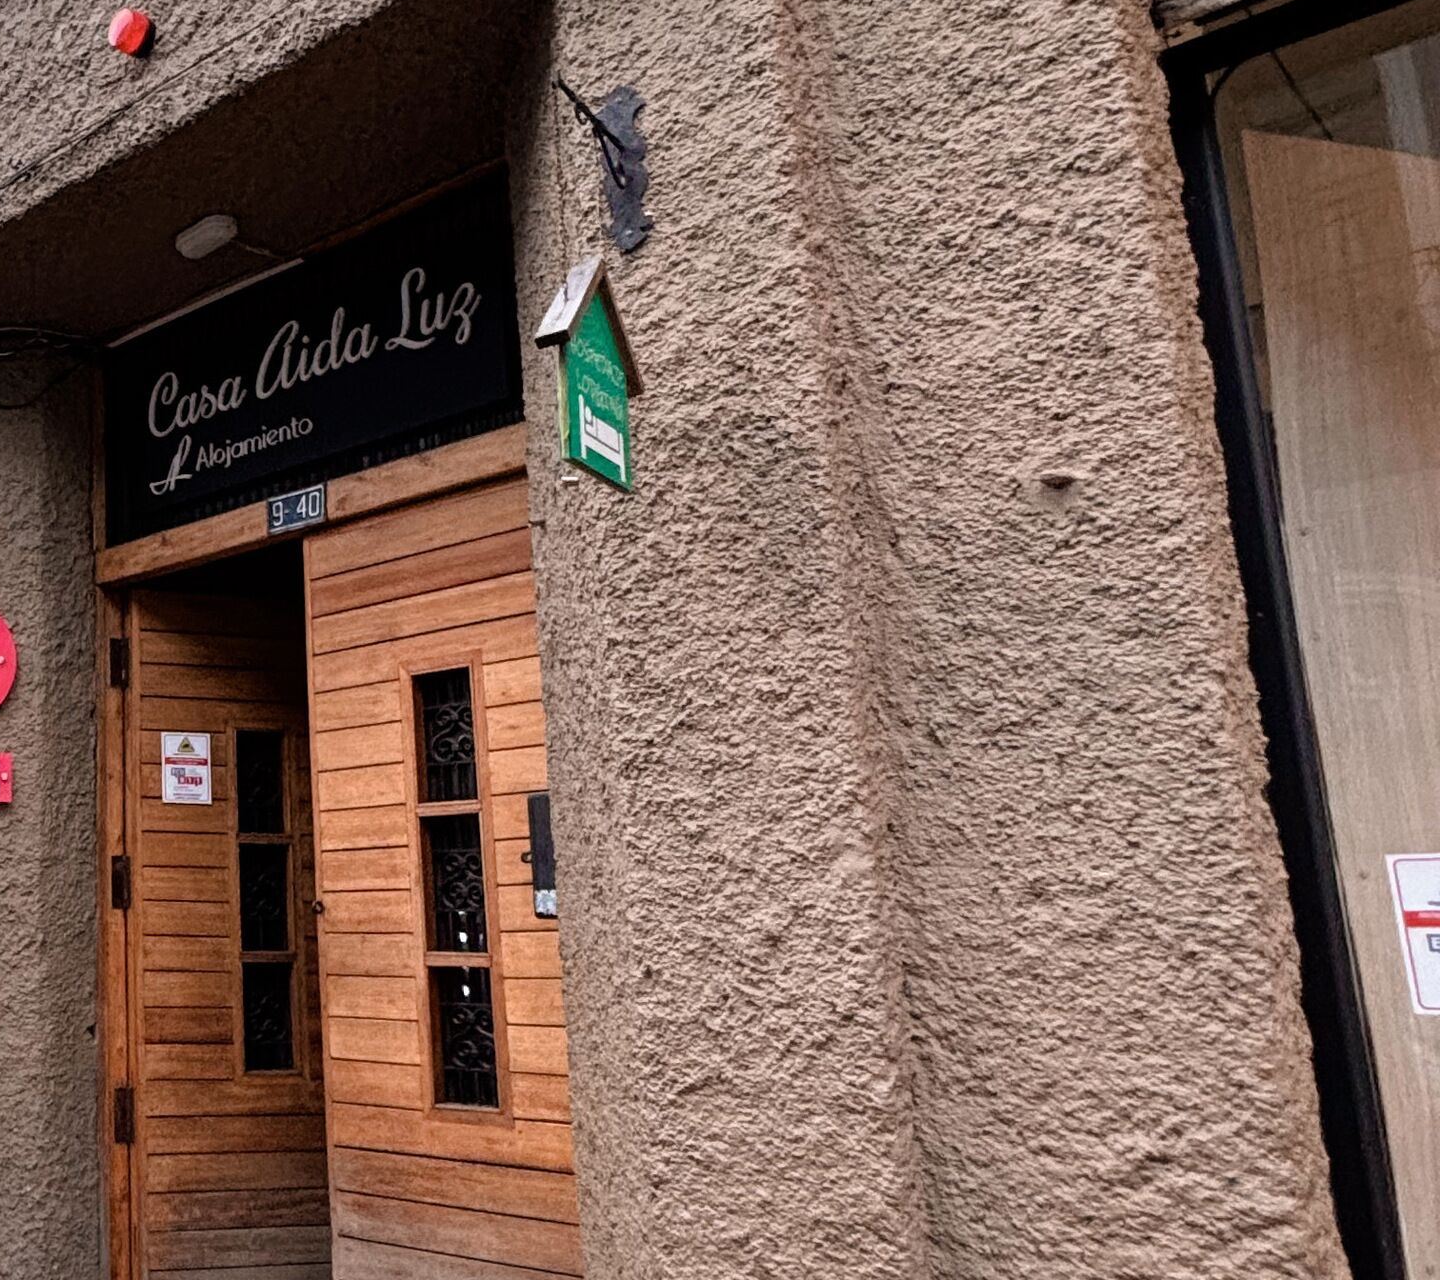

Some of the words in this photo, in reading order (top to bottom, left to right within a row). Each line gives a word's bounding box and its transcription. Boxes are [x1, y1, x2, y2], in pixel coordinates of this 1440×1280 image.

[148, 371, 247, 438] Casa
[255, 306, 379, 400] Aida
[385, 267, 482, 350] Luz
[195, 417, 314, 472] Alojamiento
